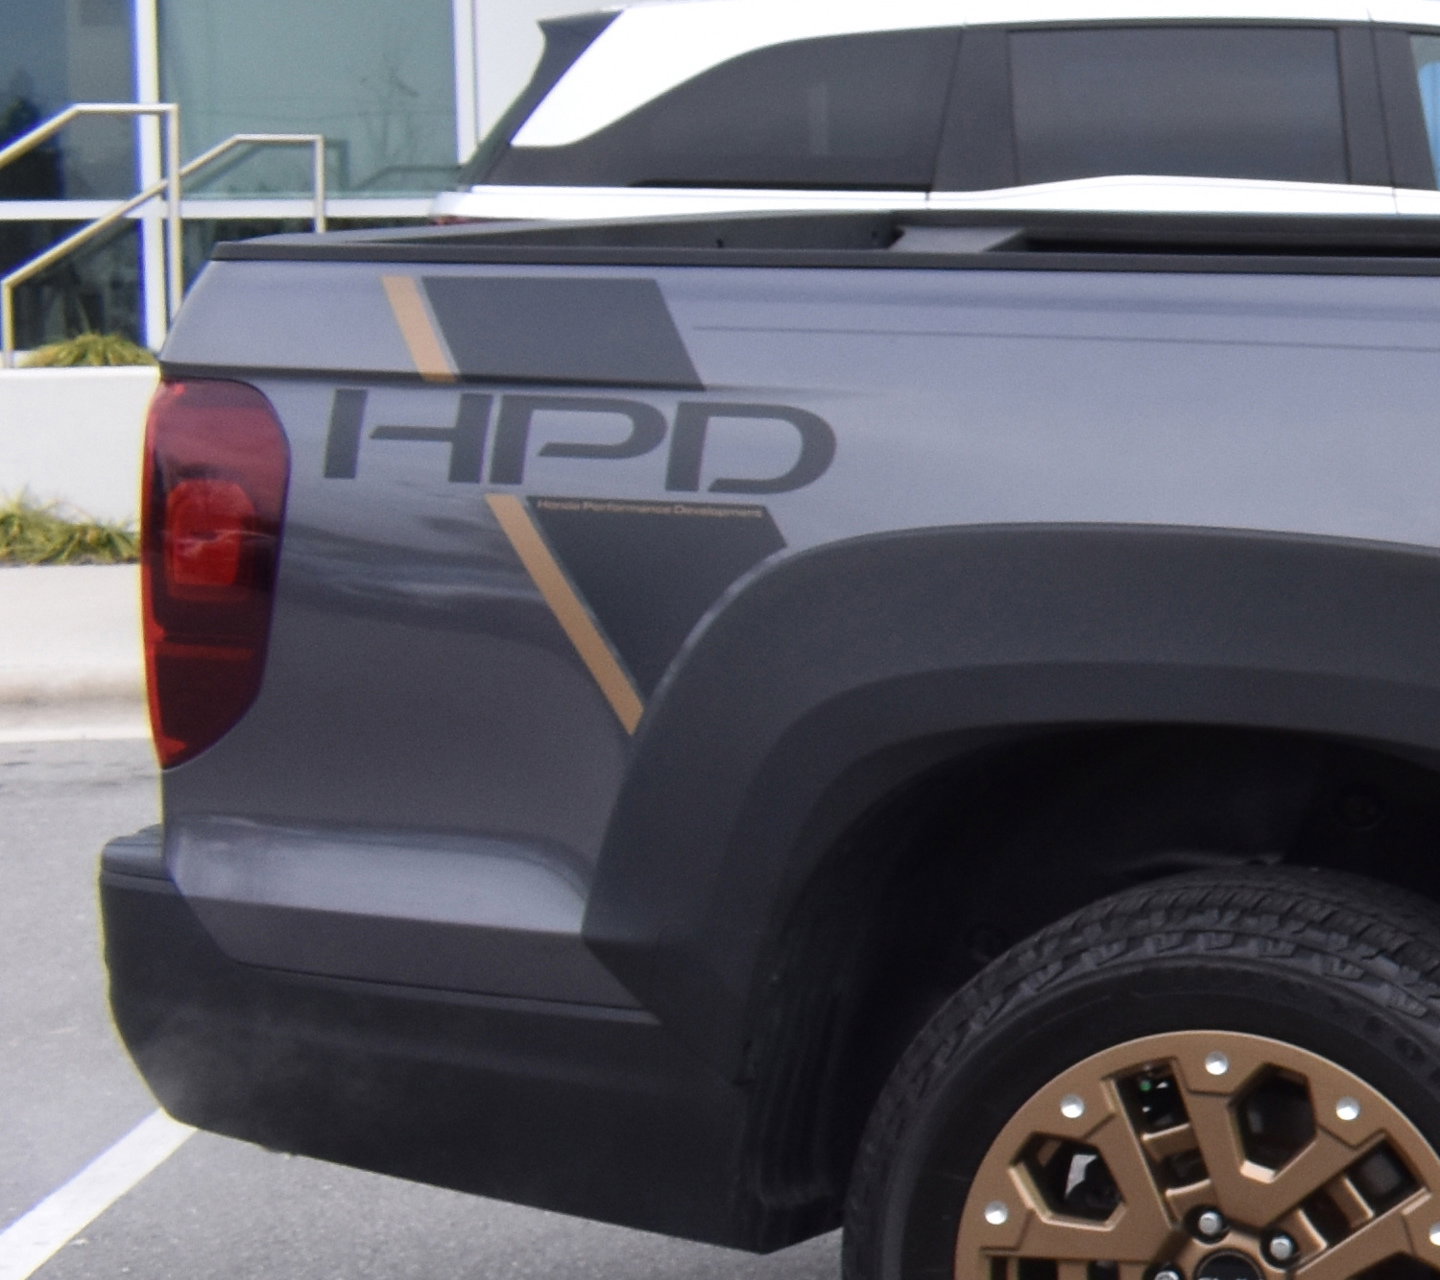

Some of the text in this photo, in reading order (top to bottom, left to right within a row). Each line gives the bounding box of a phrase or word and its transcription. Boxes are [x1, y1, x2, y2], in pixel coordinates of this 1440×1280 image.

[323, 388, 837, 494] HPD
[537, 499, 763, 519] Honda Performance Development
